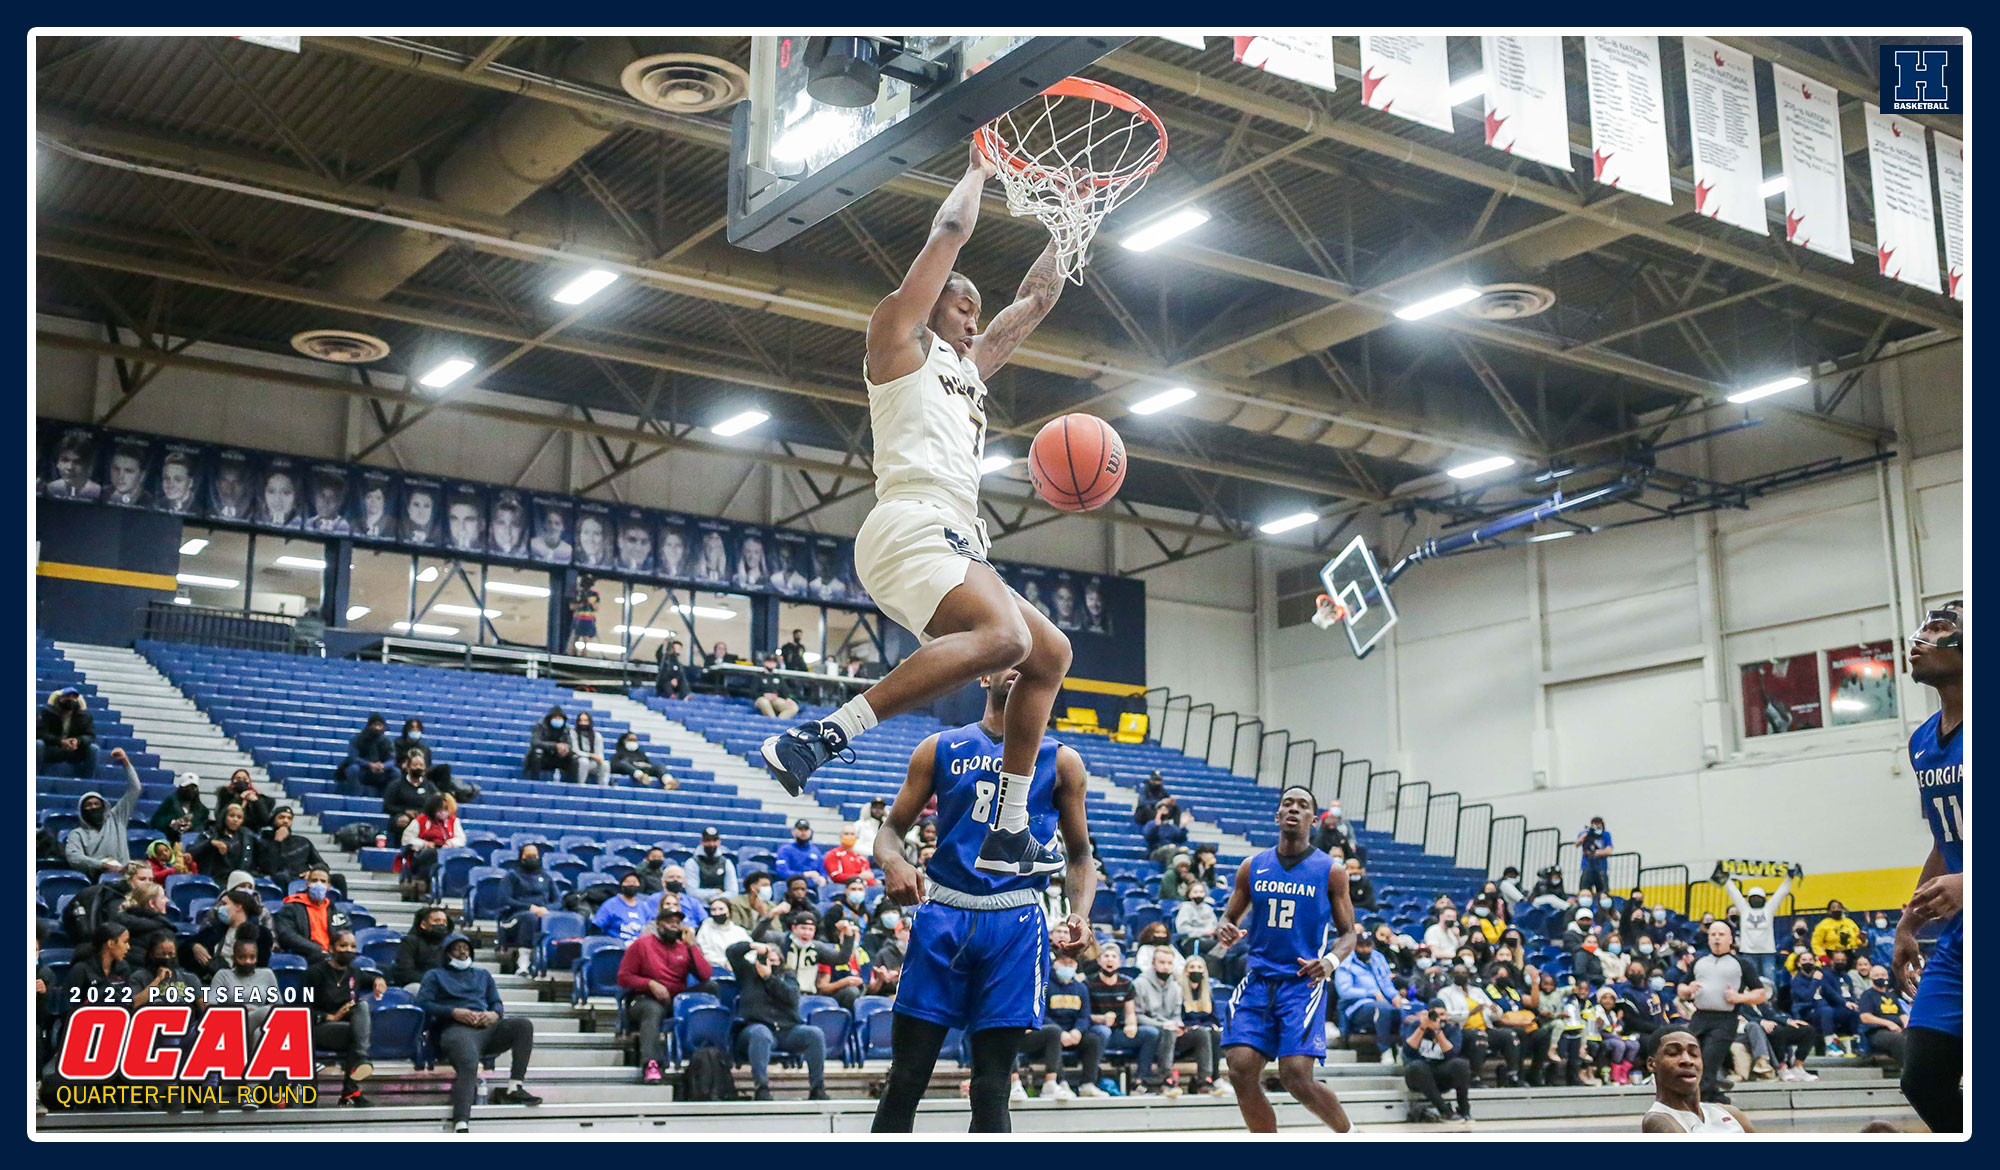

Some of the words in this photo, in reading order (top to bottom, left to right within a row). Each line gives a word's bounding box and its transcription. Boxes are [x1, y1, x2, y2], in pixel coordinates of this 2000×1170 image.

[1722, 860, 1789, 877] HAWKS
[1254, 880, 1316, 898] GEORGIAN
[1267, 898, 1296, 929] 12
